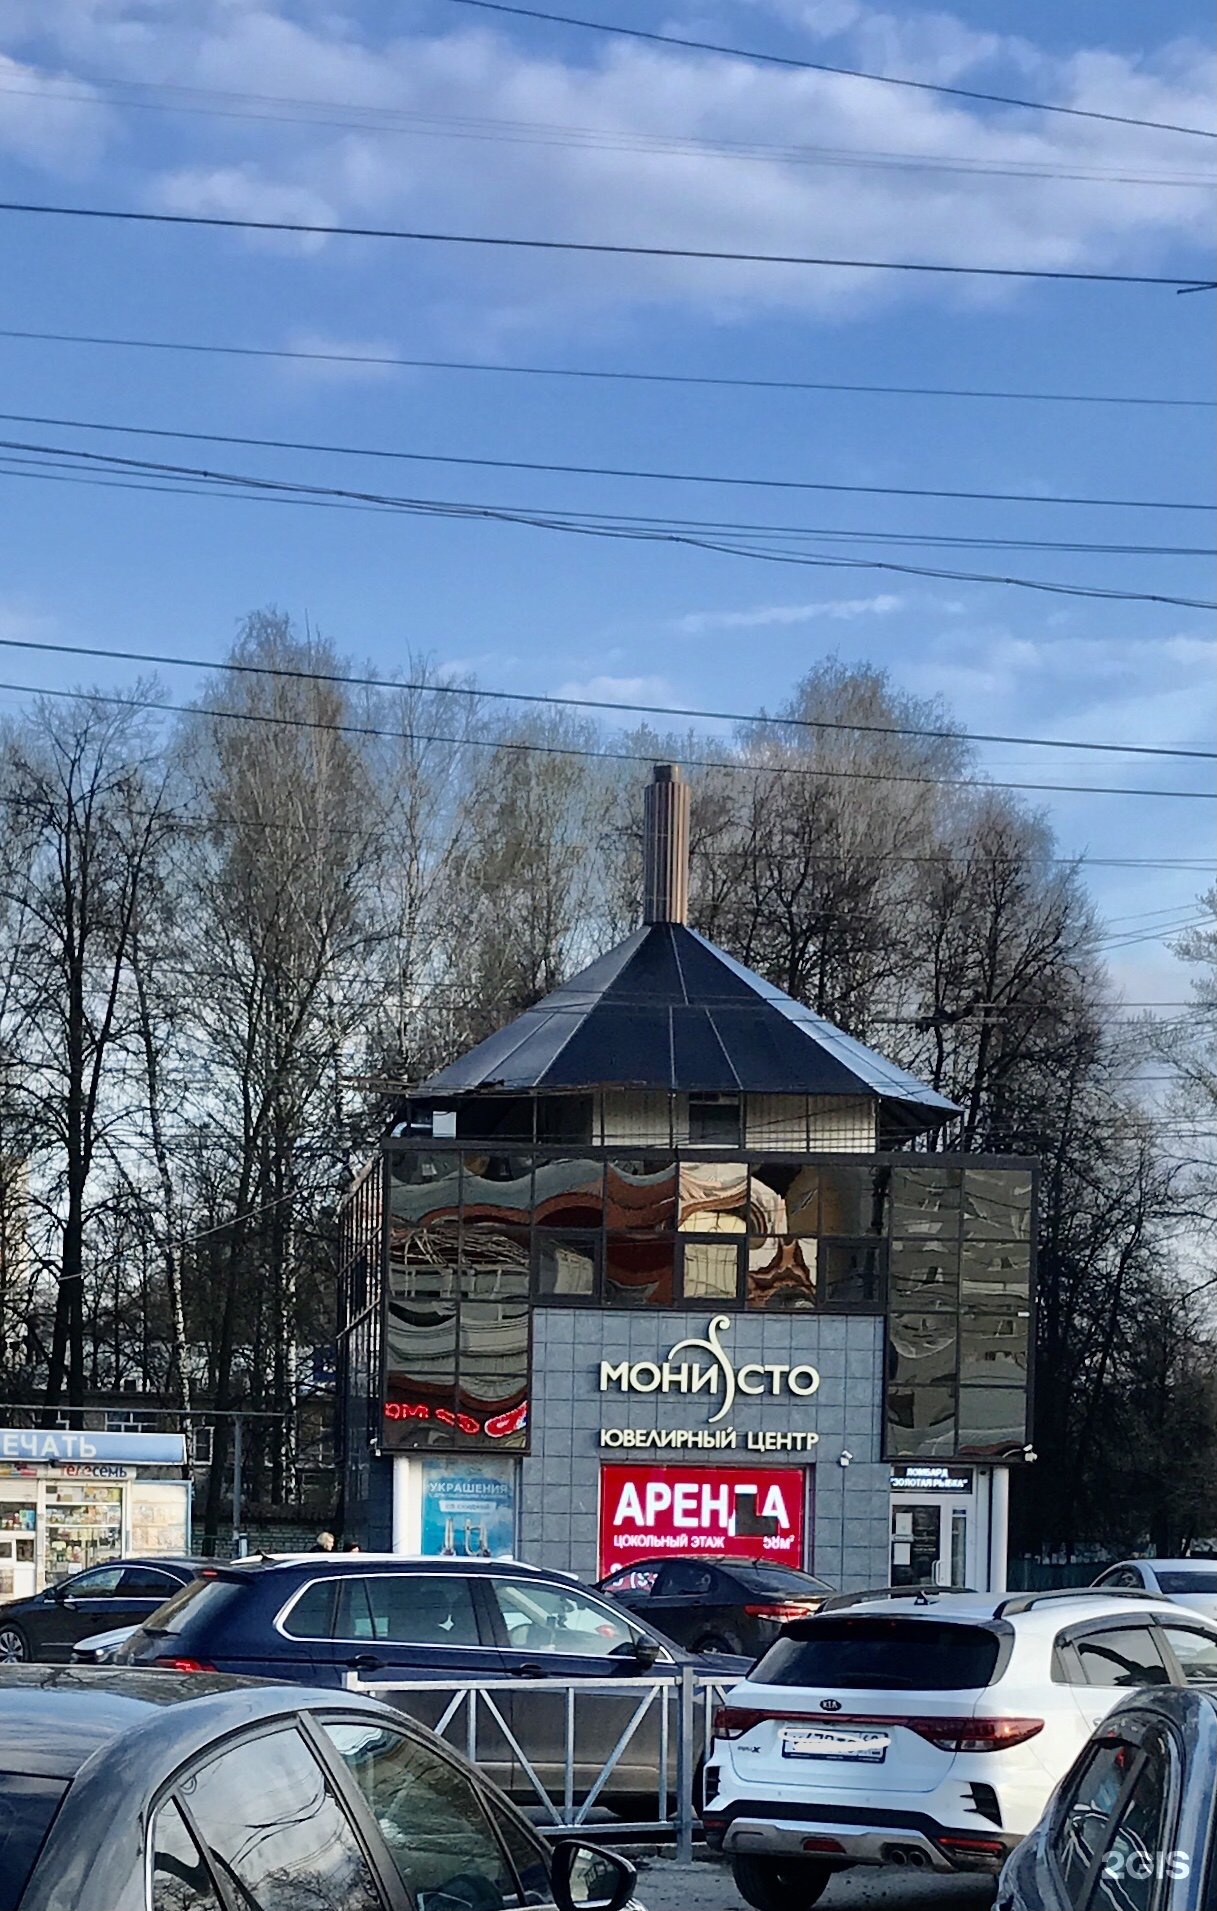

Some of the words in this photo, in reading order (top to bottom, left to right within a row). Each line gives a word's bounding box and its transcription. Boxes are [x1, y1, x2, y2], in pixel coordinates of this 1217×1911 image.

[600, 1360, 820, 1396] МОНИСТО
[3, 1434, 97, 1458] ЕЧАТЬ
[600, 1427, 737, 1449] ЮВЕЛИРНЫЙ
[747, 1431, 820, 1452] ЦЕНТР
[429, 1482, 508, 1494] УКРАШЕНИЯ
[613, 1534, 687, 1549] ЦОКОЛЬНЫЙ
[690, 1536, 726, 1549] ЭТАЖ
